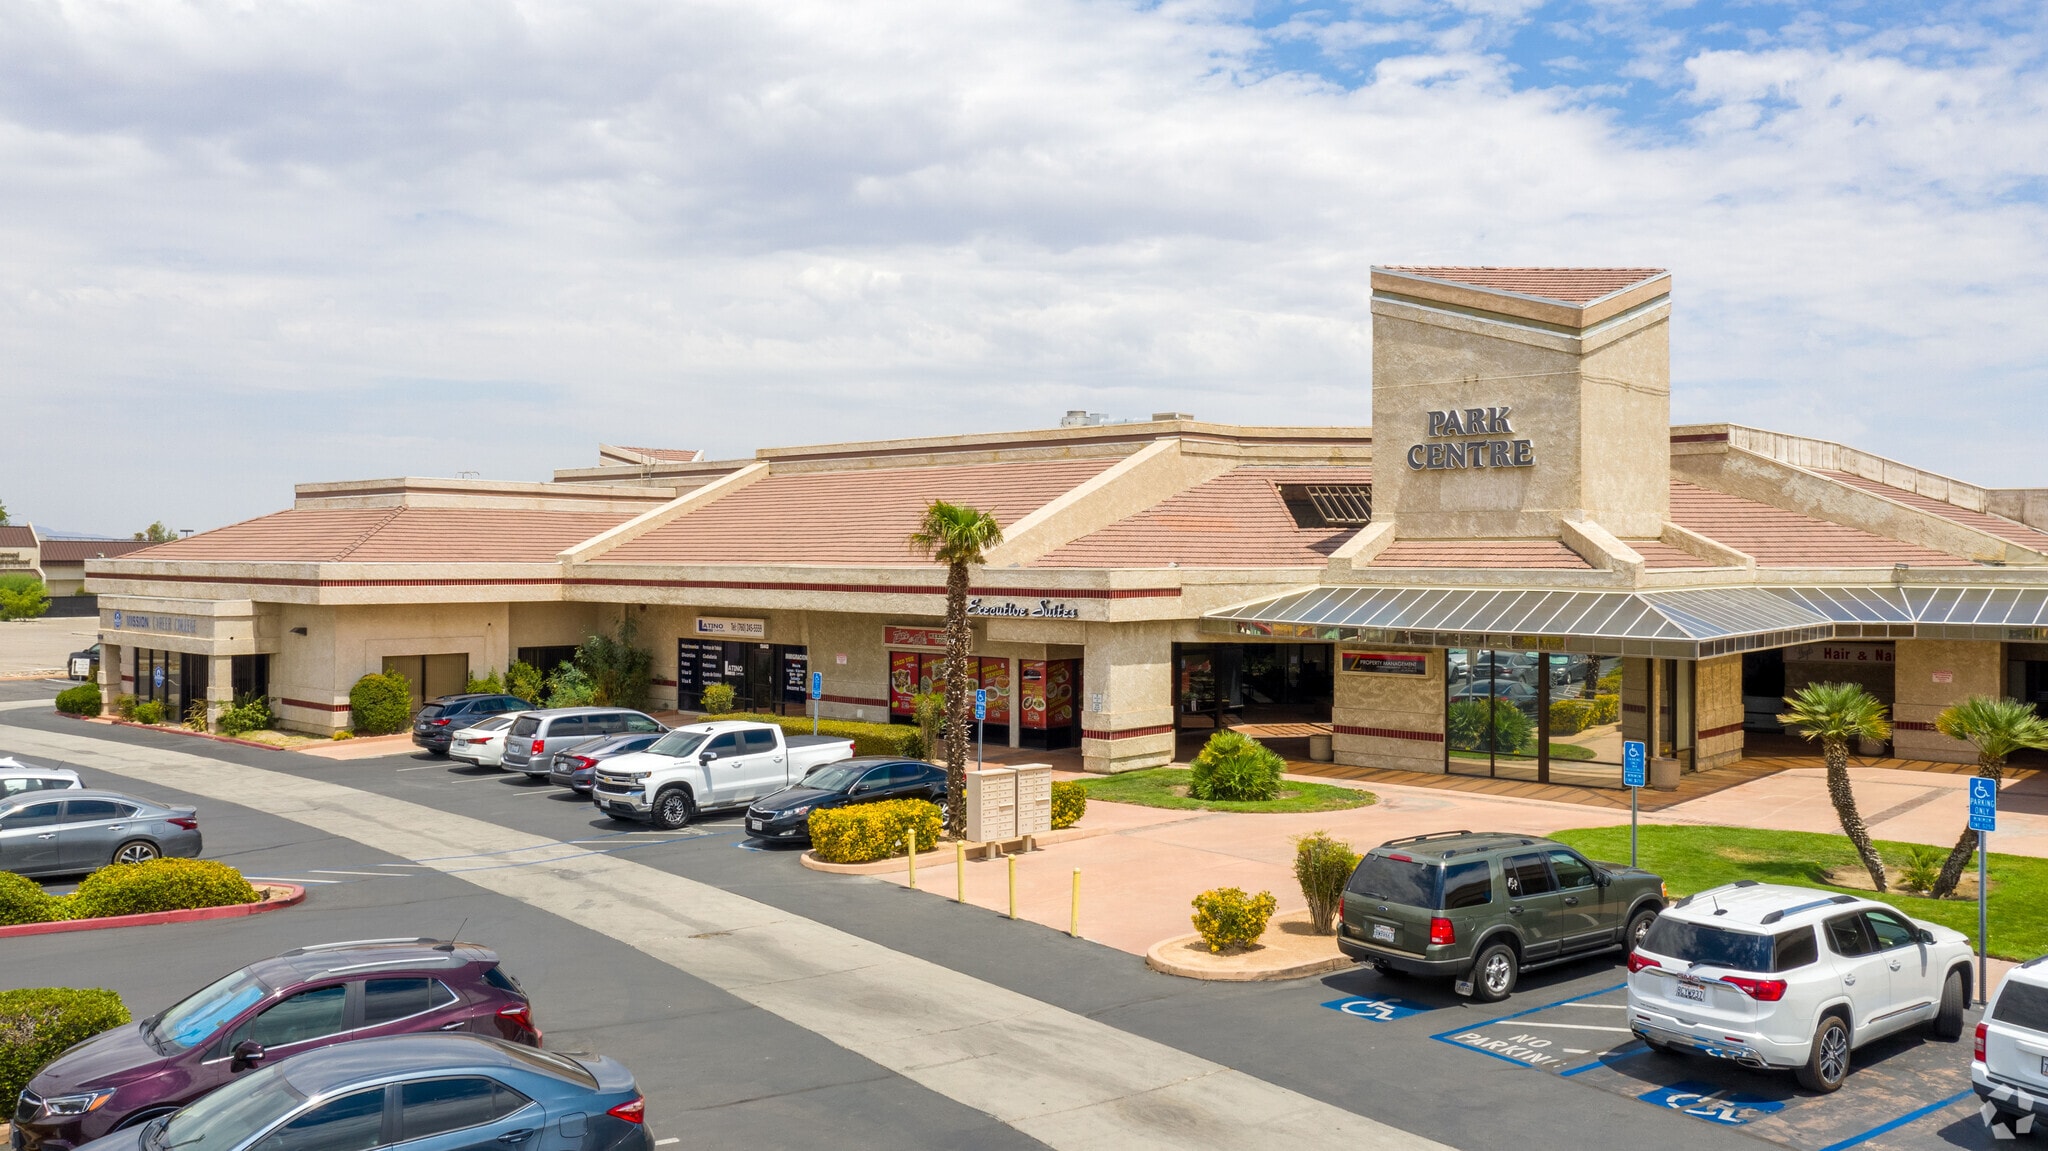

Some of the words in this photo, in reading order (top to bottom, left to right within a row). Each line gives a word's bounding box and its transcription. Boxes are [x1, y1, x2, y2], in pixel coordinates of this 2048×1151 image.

[1427, 407, 1515, 437] PARK
[1407, 439, 1537, 470] CENTRE
[967, 599, 1029, 617] Executive
[1032, 600, 1079, 619] Suites
[126, 615, 149, 628] MISSION
[152, 617, 172, 631] CAREER
[699, 620, 724, 632] LATINO
[1824, 648, 1850, 660] Hair
[1858, 651, 1867, 660] &
[724, 660, 744, 676] LATINO
[1970, 798, 1995, 808] PARKING
[1975, 807, 1990, 815] ONLY
[1508, 1034, 1553, 1048] NO
